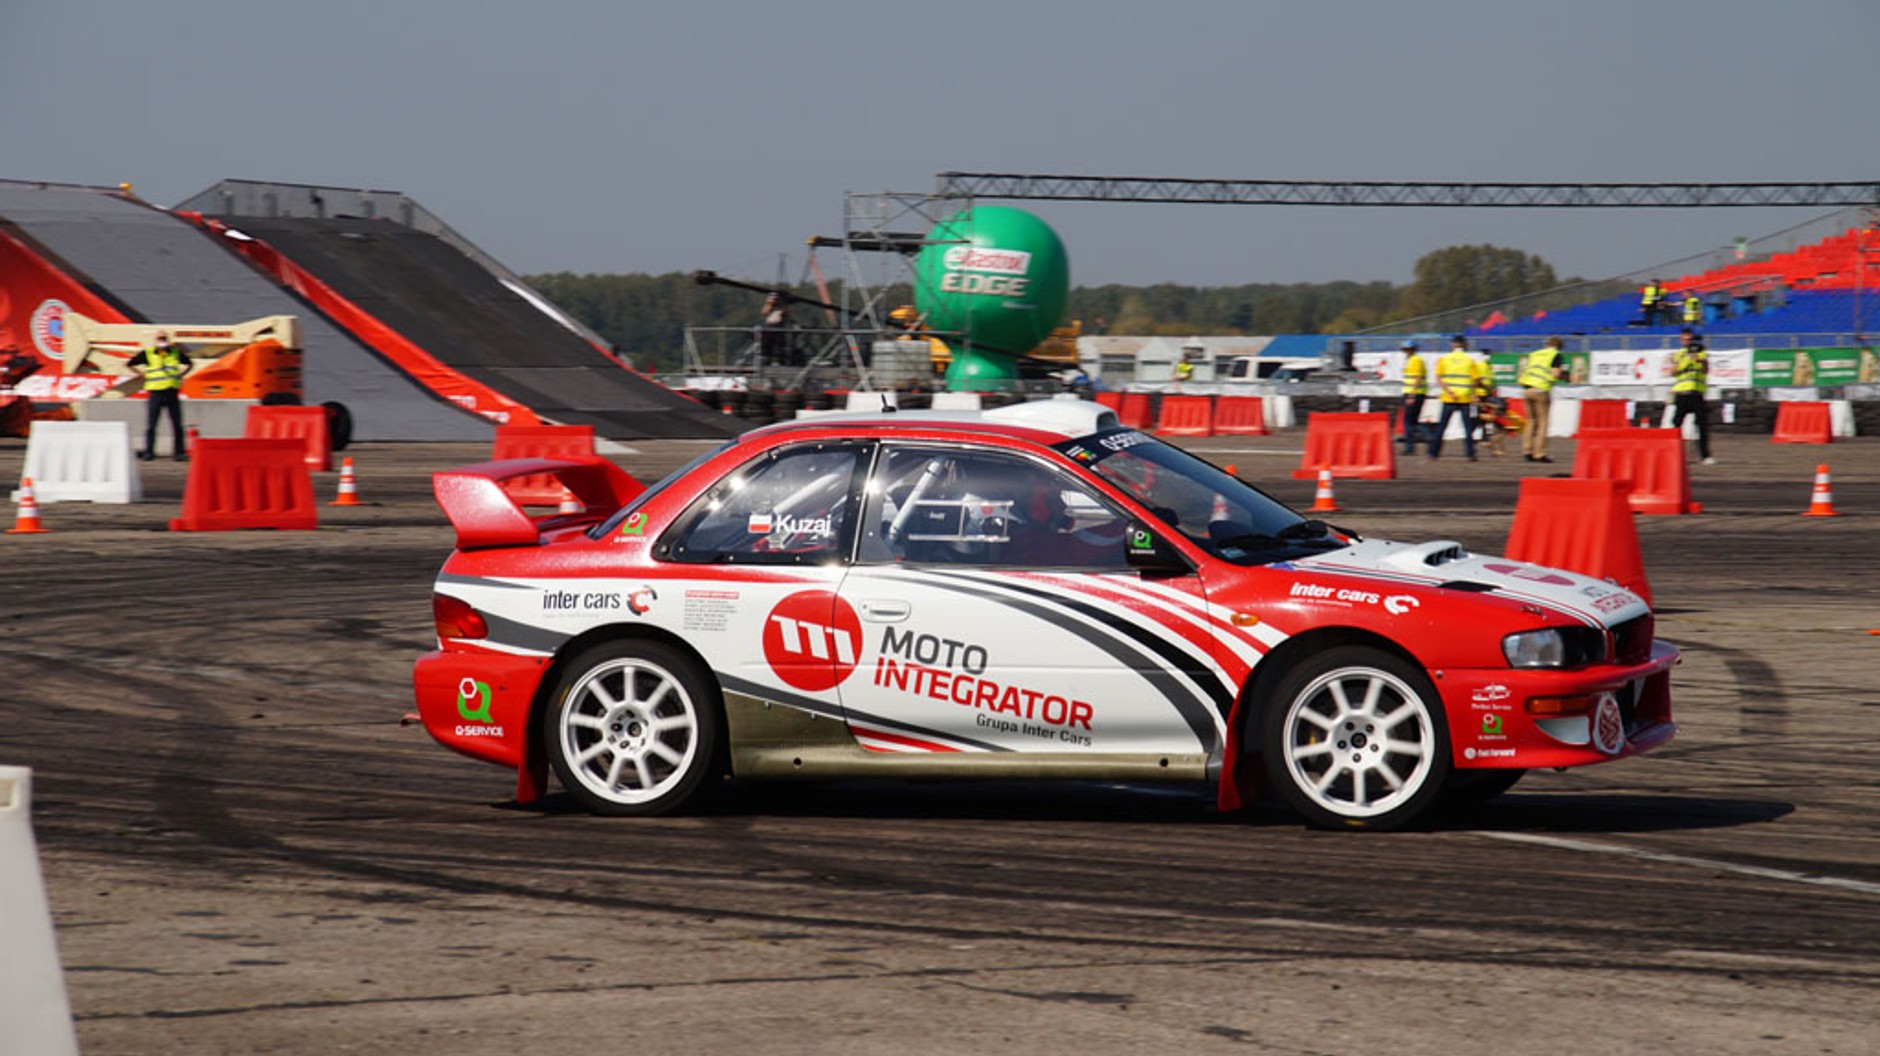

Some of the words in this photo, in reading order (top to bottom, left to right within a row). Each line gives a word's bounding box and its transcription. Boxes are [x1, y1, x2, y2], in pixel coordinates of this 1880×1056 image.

[942, 273, 1029, 297] EDGE
[776, 514, 832, 538] Kuzaj
[543, 589, 580, 609] inter
[584, 593, 621, 609] cars
[1337, 589, 1380, 604] cars
[880, 626, 988, 675] MOTO
[874, 657, 1093, 731] INTEGRATOR
[455, 725, 504, 737] Q-SERVICE
[976, 713, 1018, 732] Grupa
[1022, 723, 1056, 739] Inter
[1059, 729, 1092, 747] Cars
